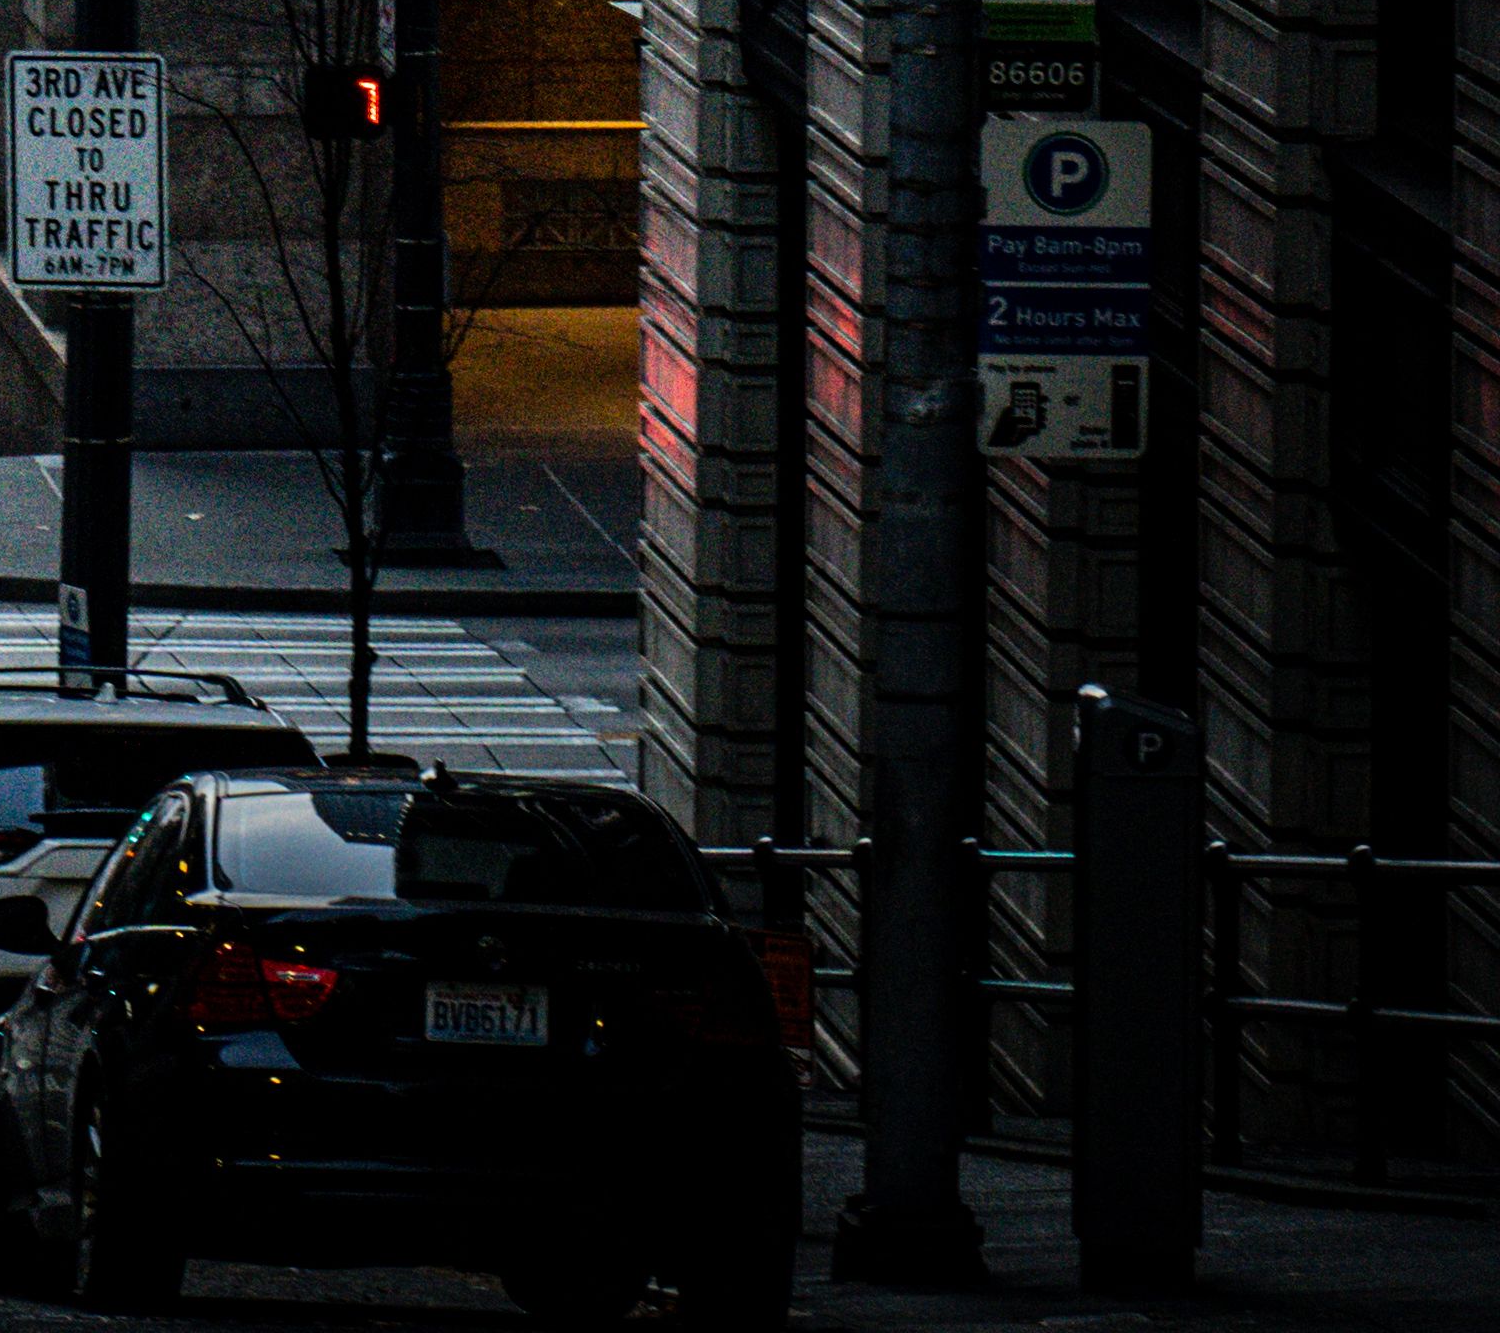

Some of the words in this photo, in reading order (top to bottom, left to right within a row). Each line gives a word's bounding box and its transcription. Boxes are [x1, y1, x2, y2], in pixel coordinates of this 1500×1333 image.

[26, 67, 81, 98] 3RD
[95, 68, 146, 99] AVE
[989, 61, 1086, 86] 86606
[28, 107, 146, 138] CLOSED
[75, 147, 104, 172] TO
[1050, 151, 1090, 197] P
[45, 181, 131, 212] THRU
[25, 218, 154, 251] TRAFFIC
[987, 234, 1029, 259] Pay
[1033, 236, 1144, 259] 8am-8pm
[44, 256, 134, 276] 6AM-7PM
[988, 296, 1008, 326] 2
[1015, 307, 1086, 328] Hours
[1093, 308, 1142, 328] Max
[1136, 731, 1164, 761] P
[434, 1001, 538, 1036] BVB6171
